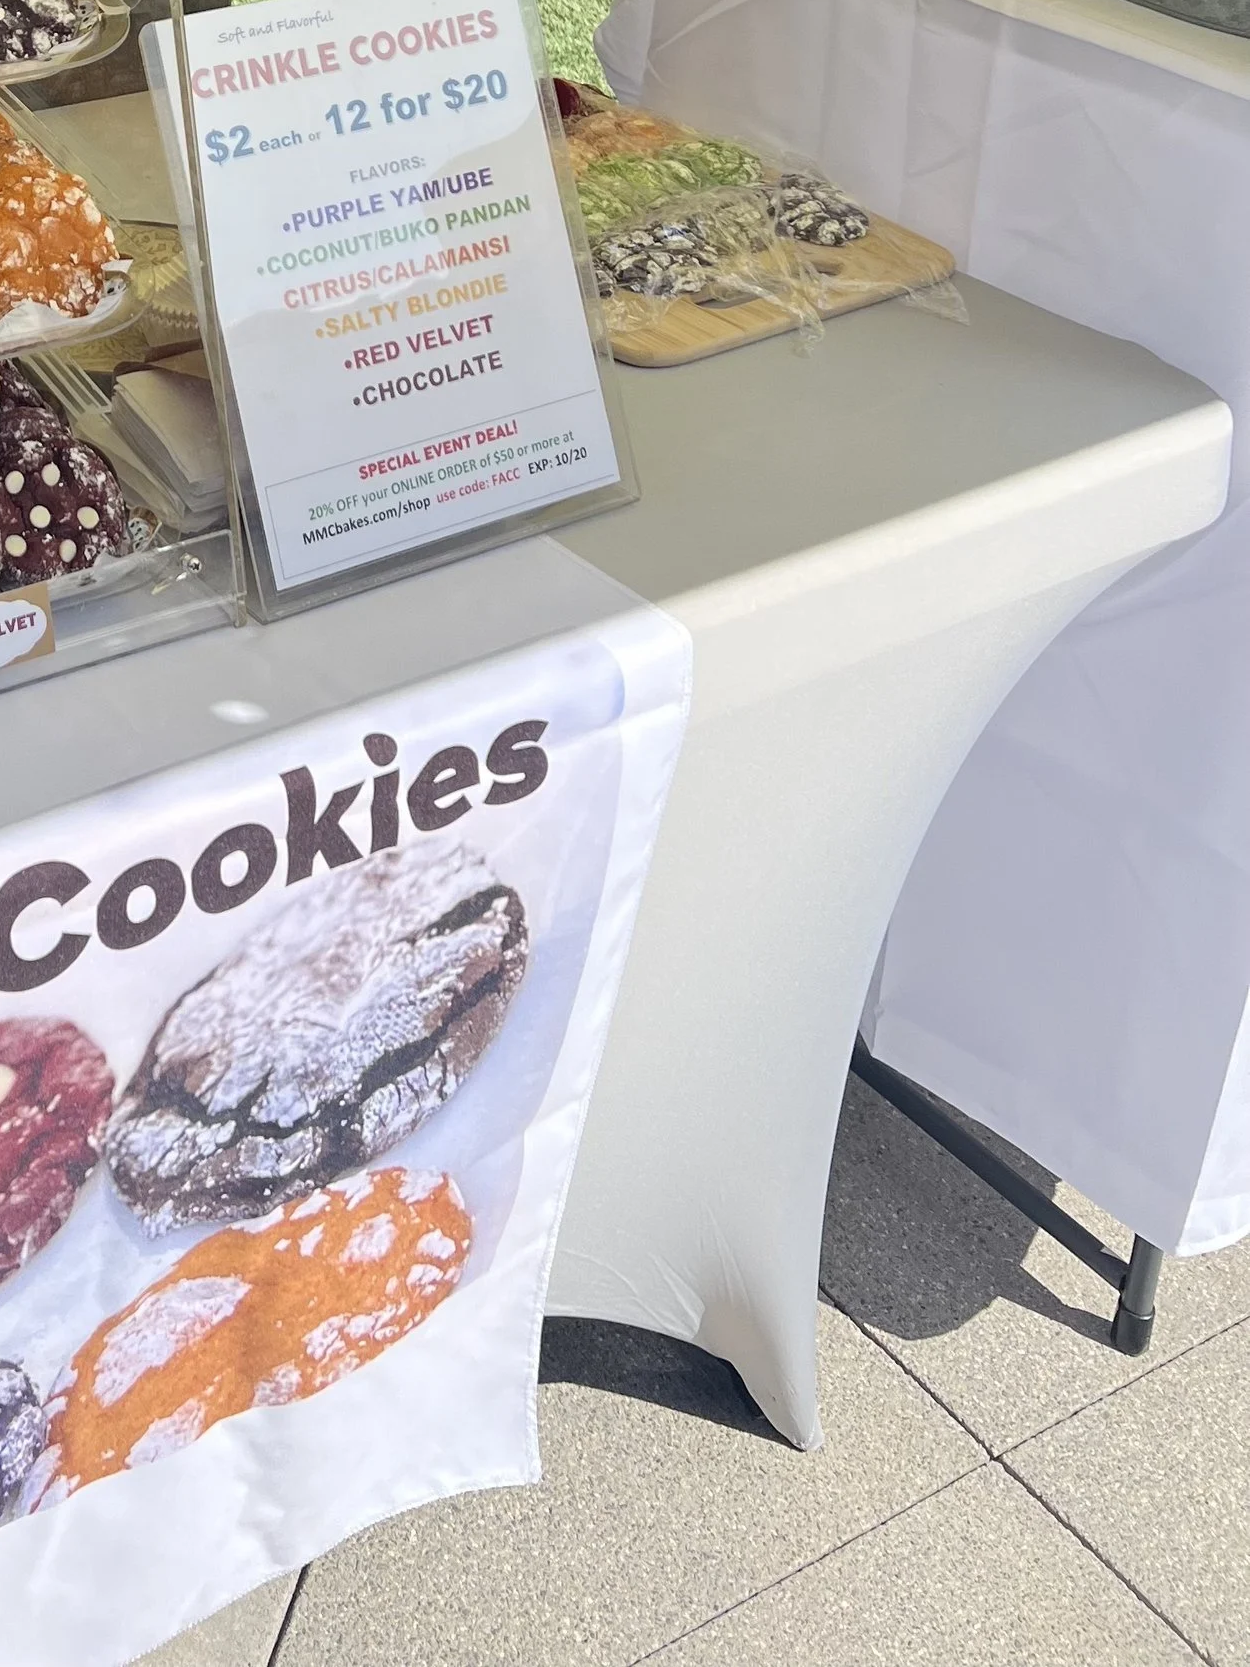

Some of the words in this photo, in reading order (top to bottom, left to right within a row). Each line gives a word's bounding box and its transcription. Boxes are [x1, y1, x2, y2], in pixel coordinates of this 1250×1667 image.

[191, 41, 341, 99] CRINKLE
[348, 9, 499, 66] COOKIES
[217, 28, 247, 45] Soft
[248, 22, 274, 37] and
[276, 10, 334, 33] Flavorful
[204, 124, 255, 166] $2
[258, 130, 303, 154] each
[308, 130, 322, 142] or
[325, 98, 372, 136] 12
[380, 90, 432, 124] for
[442, 69, 509, 113] $20
[291, 193, 384, 233] PURPLE
[390, 167, 494, 208] YAM/UBE
[349, 155, 426, 184] FLAVORS:
[266, 216, 440, 276] COCONUT/BUKO
[445, 194, 531, 231] PANDAN
[283, 234, 511, 311] CITRUS/CALAMANSI
[324, 301, 400, 339] SALTY
[406, 273, 509, 317] BLONDIE
[353, 340, 400, 370] RED
[406, 314, 494, 355] VELVET
[362, 350, 504, 405] CHOCOLATE
[308, 501, 334, 522] 20%
[336, 494, 359, 513] OFF
[361, 486, 389, 507] your
[391, 474, 436, 496] ONLINE
[437, 459, 478, 482] ORDER
[480, 454, 492, 469] of
[493, 446, 515, 466] $50
[516, 446, 528, 457] or
[530, 435, 561, 454] more
[563, 430, 575, 444] at
[358, 450, 421, 480] SPECIAL
[423, 434, 472, 463] EVENT
[475, 419, 518, 446] DEAL!
[302, 496, 431, 546] MMCbakes.com/shop
[436, 489, 456, 504] use
[458, 479, 490, 498] code:
[491, 467, 521, 487] FACC
[527, 458, 553, 476] EXP:
[555, 446, 588, 469] 10/20
